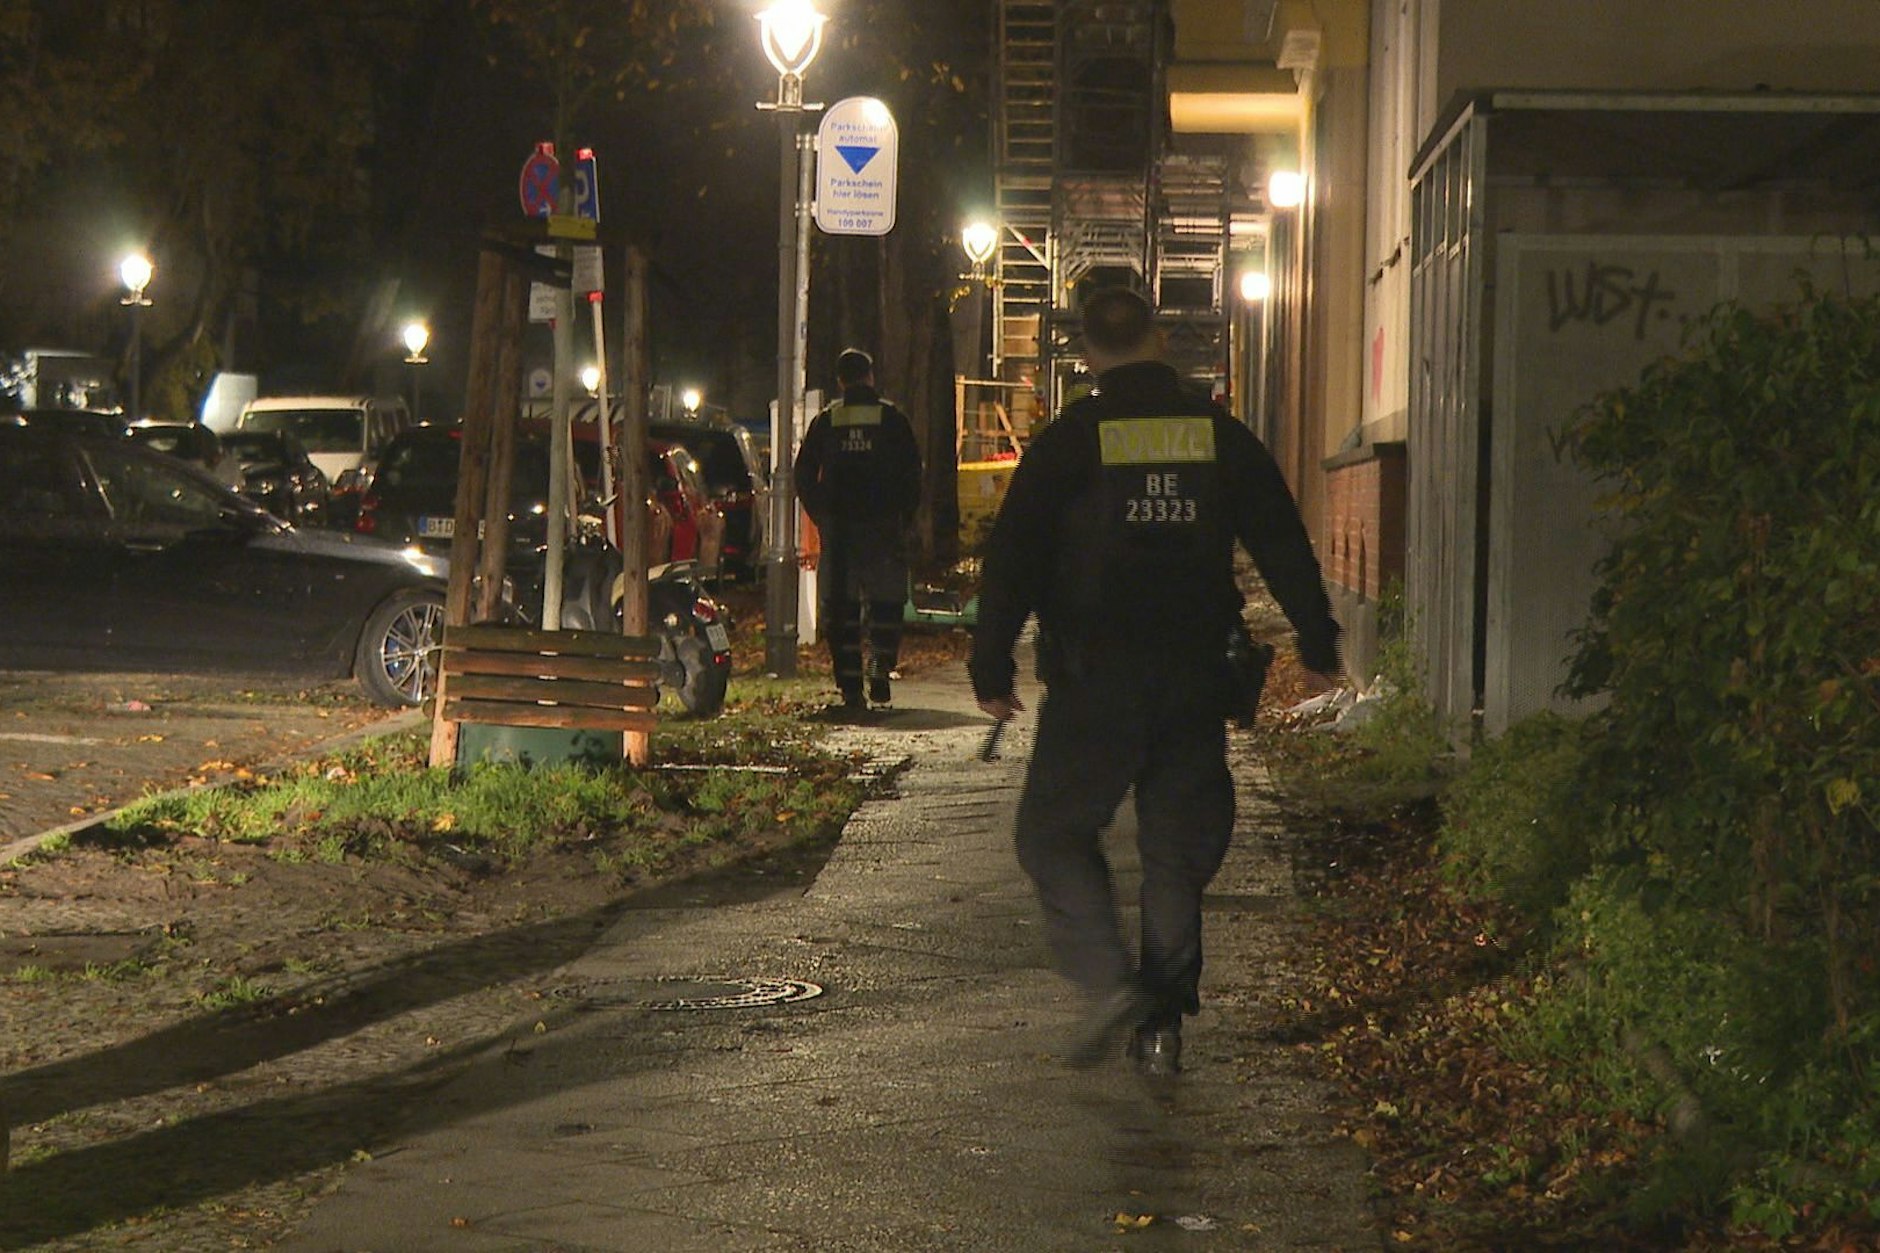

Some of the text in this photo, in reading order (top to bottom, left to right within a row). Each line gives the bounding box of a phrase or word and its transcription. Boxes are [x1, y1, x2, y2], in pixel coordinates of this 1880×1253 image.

[831, 178, 883, 188] Parkschein
[833, 190, 851, 199] hier
[839, 218, 853, 228] 100
[1146, 473, 1179, 496] BE
[1125, 499, 1196, 522] 23323
